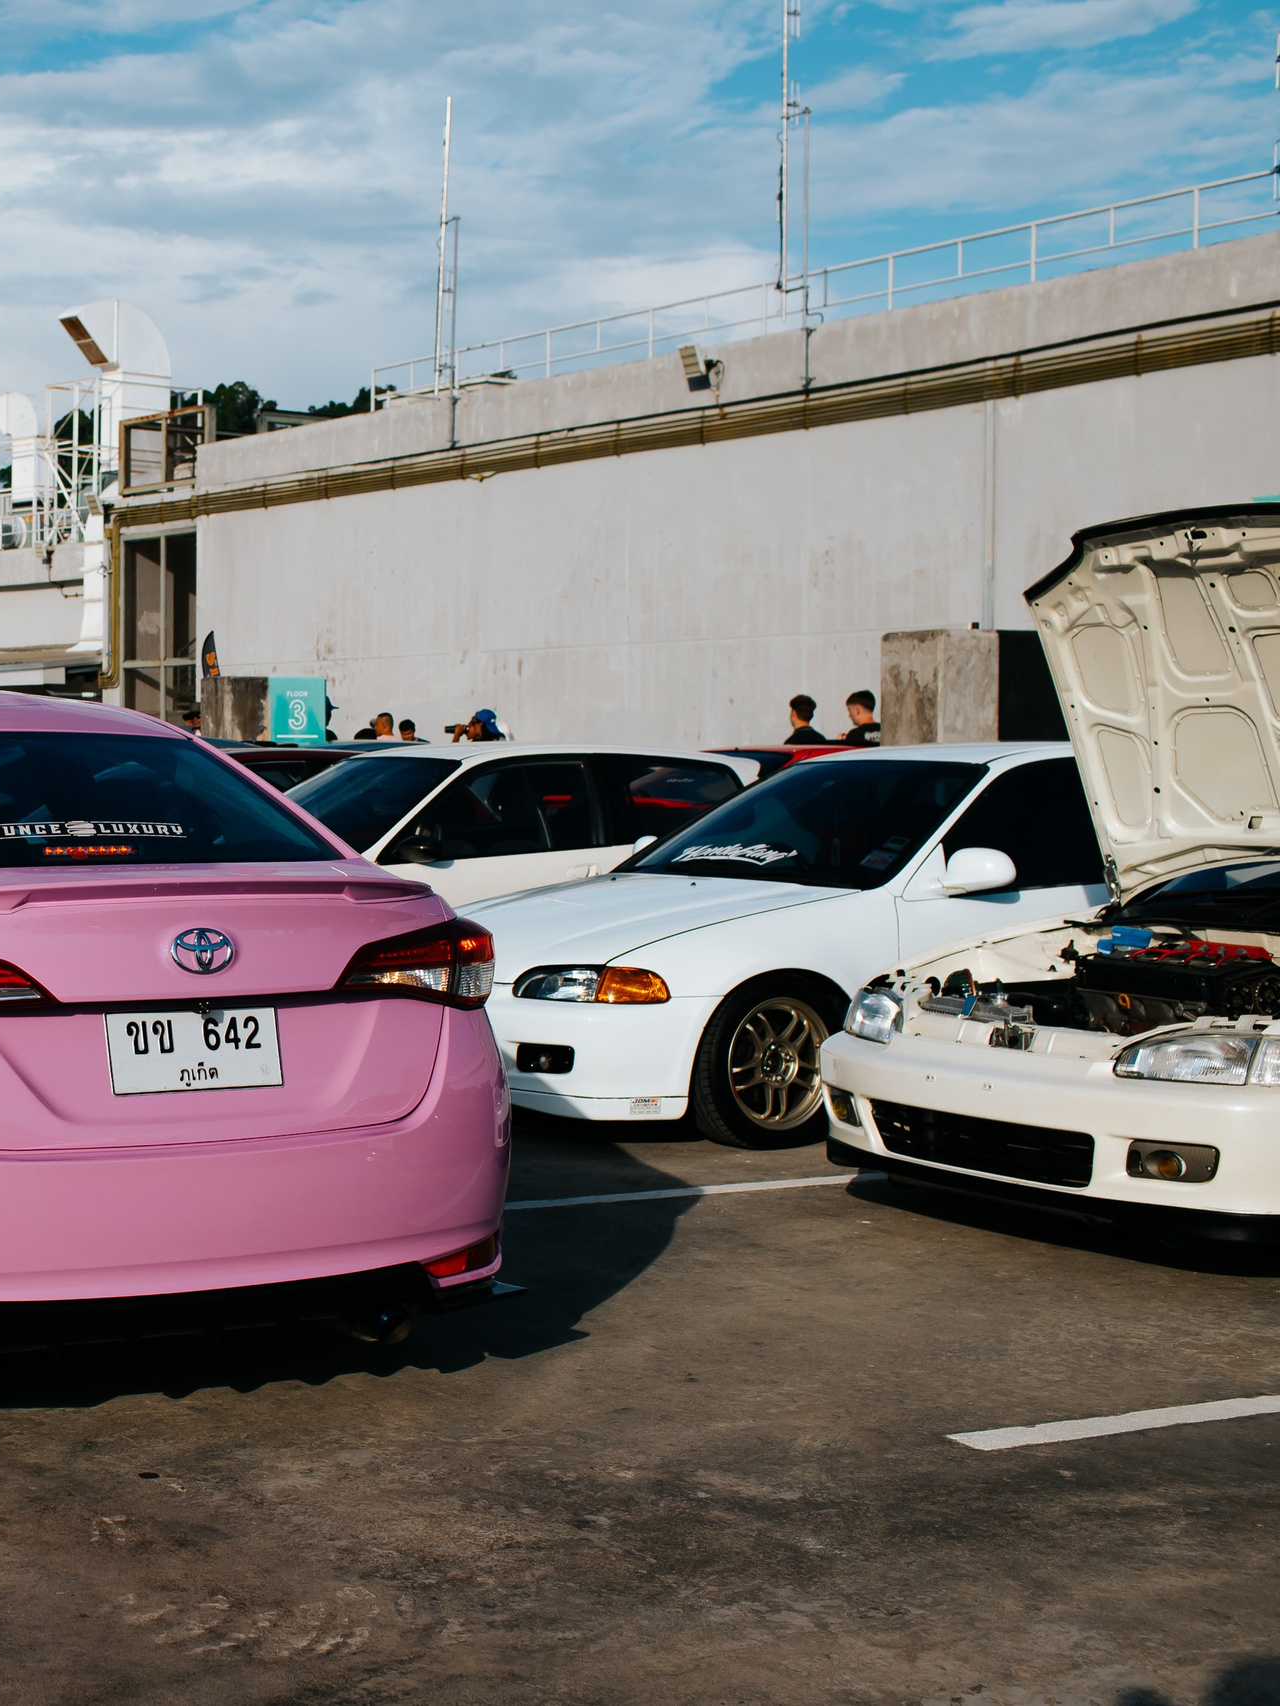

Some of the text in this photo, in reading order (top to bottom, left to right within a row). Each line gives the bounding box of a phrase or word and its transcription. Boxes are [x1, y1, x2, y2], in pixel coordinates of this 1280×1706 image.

[288, 699, 307, 730] 3
[97, 823, 184, 836] LUXURY
[126, 1016, 261, 1055] ขข 642
[179, 1061, 219, 1087] ภูเก็ต
